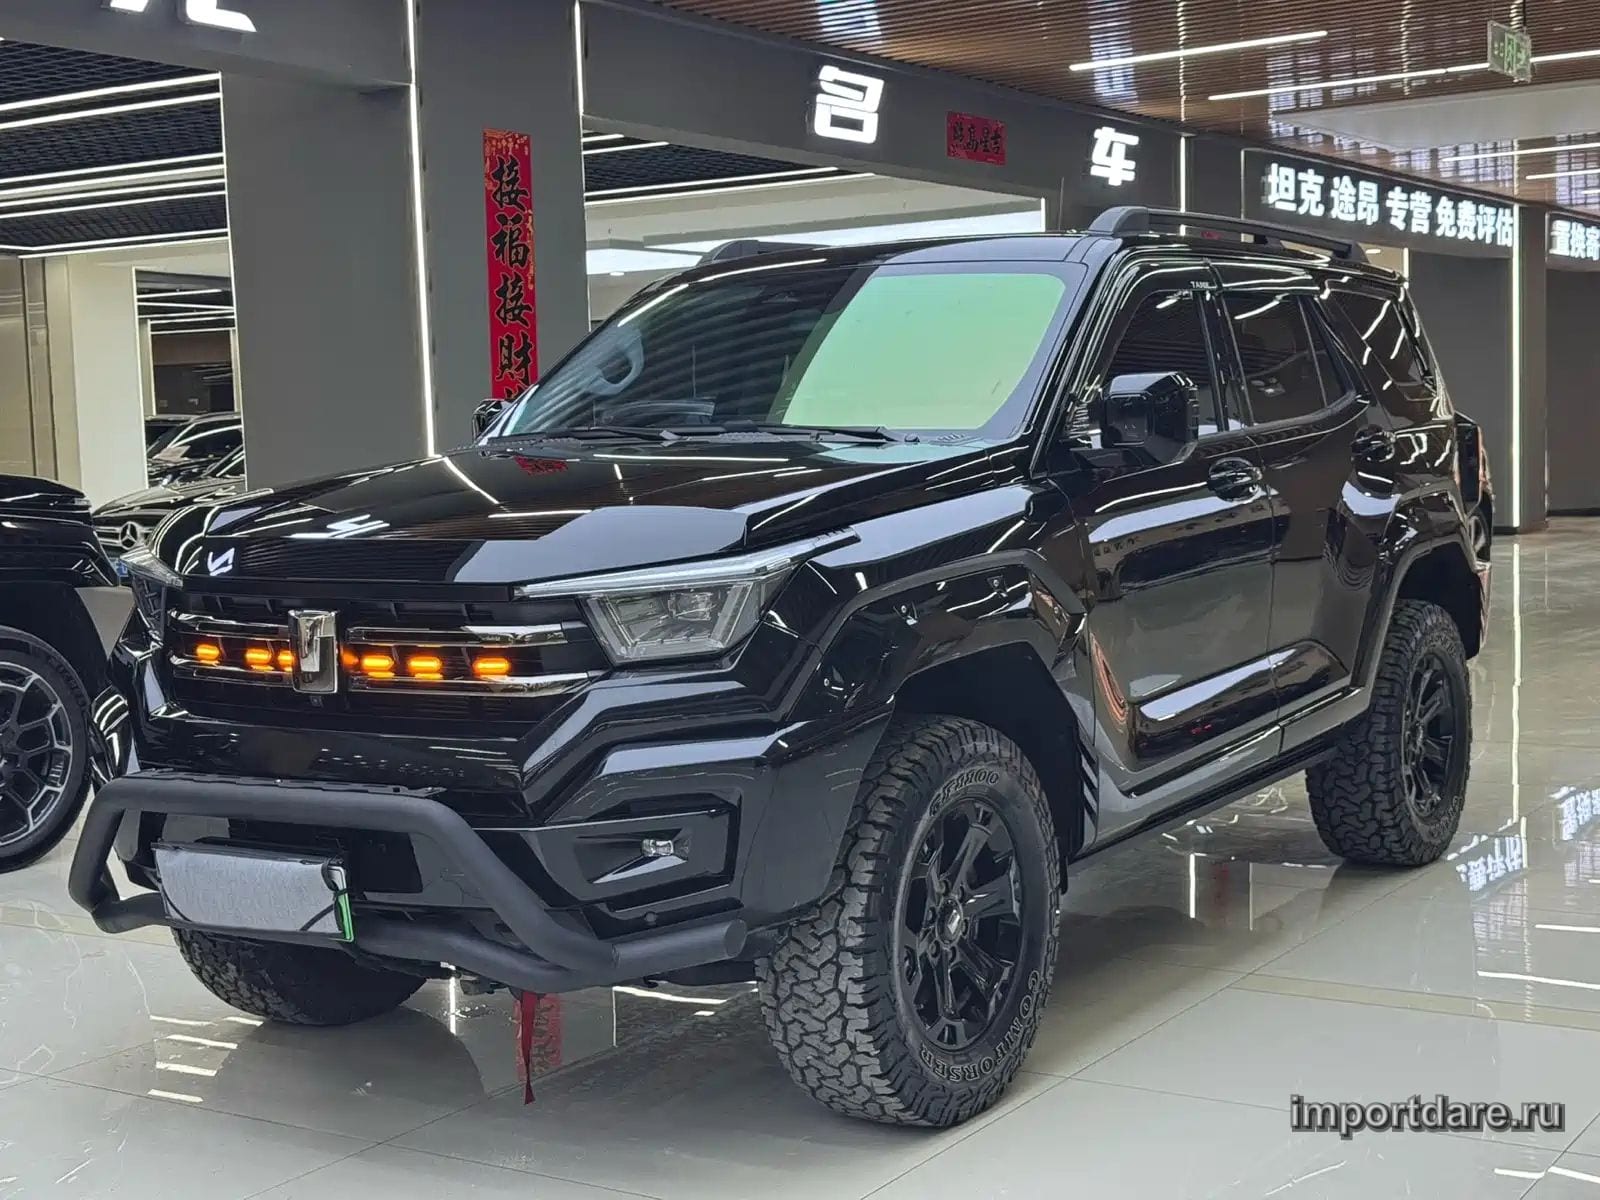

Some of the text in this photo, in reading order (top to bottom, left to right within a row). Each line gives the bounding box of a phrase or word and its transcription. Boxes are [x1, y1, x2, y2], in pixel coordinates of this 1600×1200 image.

[814, 65, 1140, 187] 名 车
[1267, 163, 1325, 216] 坦克
[1330, 176, 1380, 226] 途昂
[1435, 196, 1514, 248] 免费评估
[920, 969, 1041, 1082] COMFORSER
